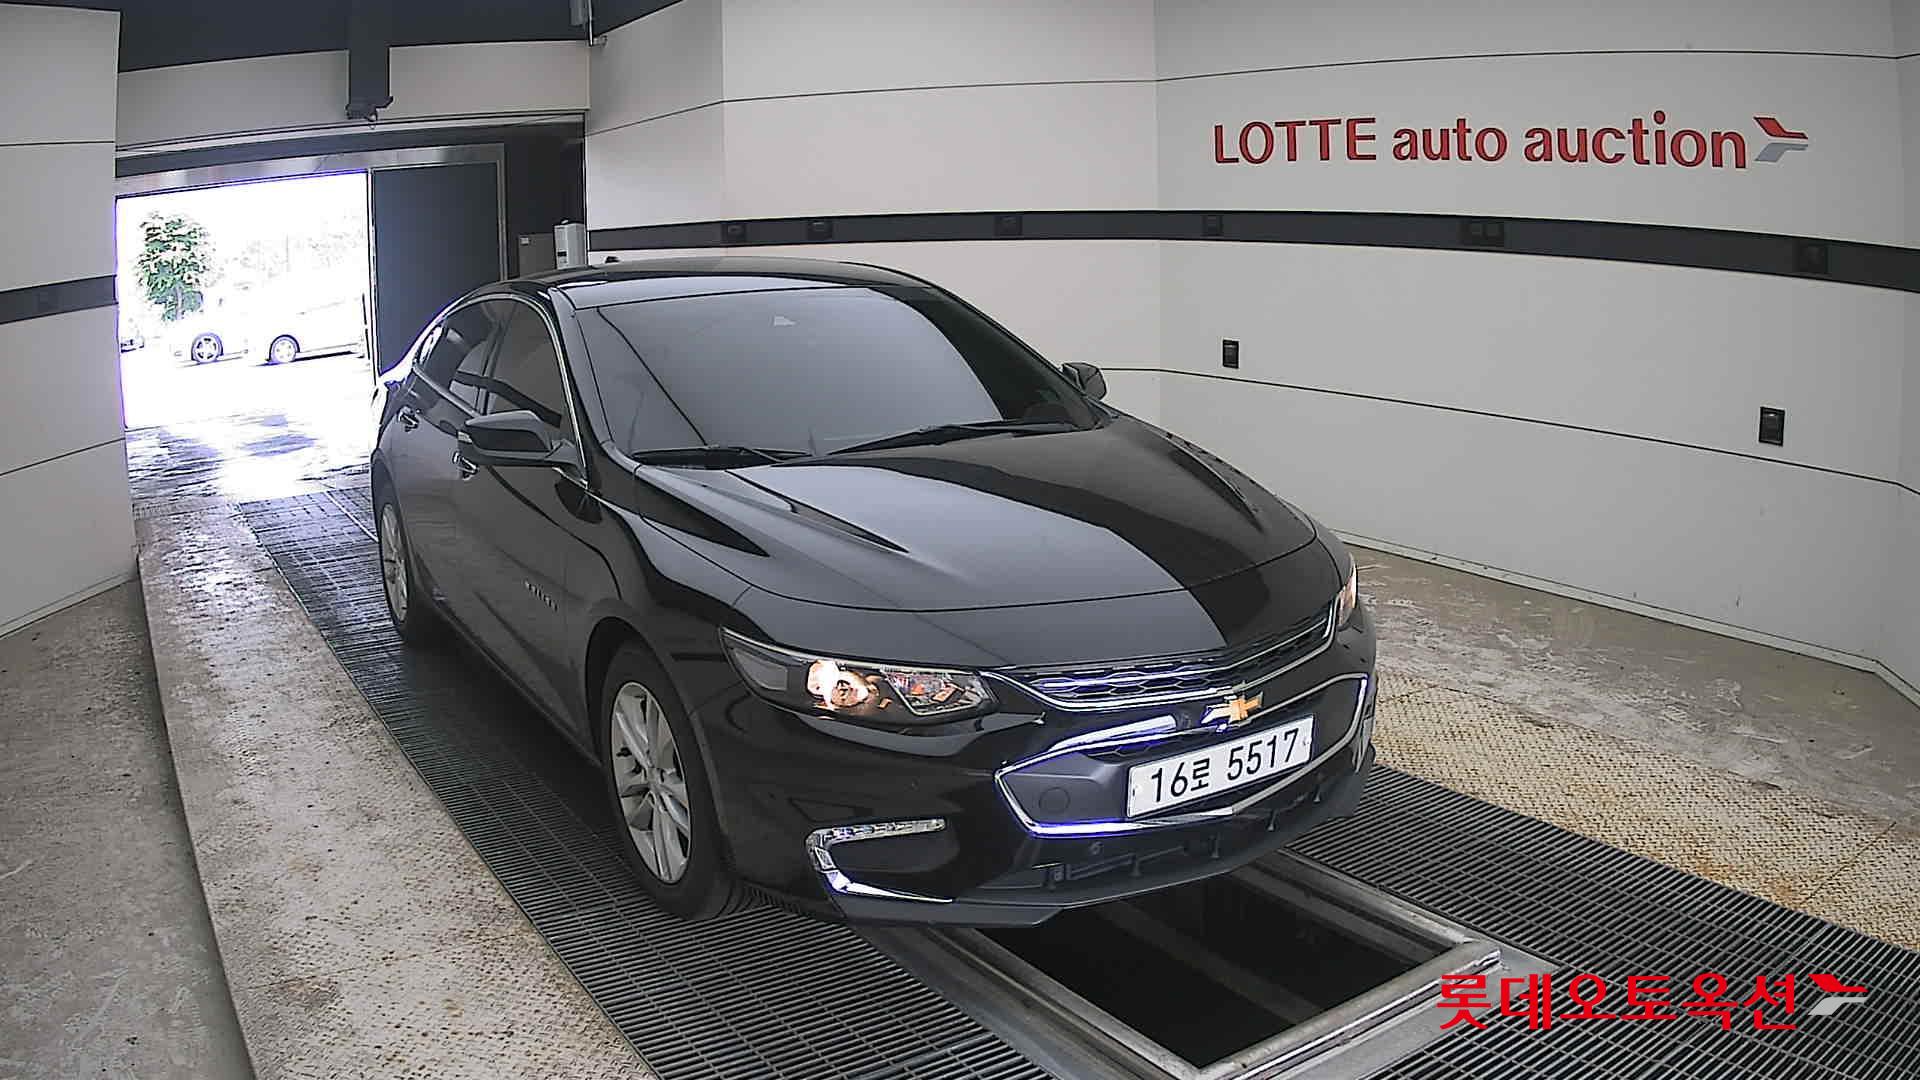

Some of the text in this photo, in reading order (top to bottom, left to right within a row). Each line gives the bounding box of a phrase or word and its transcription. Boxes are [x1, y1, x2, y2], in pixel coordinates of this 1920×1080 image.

[1213, 110, 1747, 169] LOTTE auto auction
[1151, 727, 1300, 802] 16로 5517
